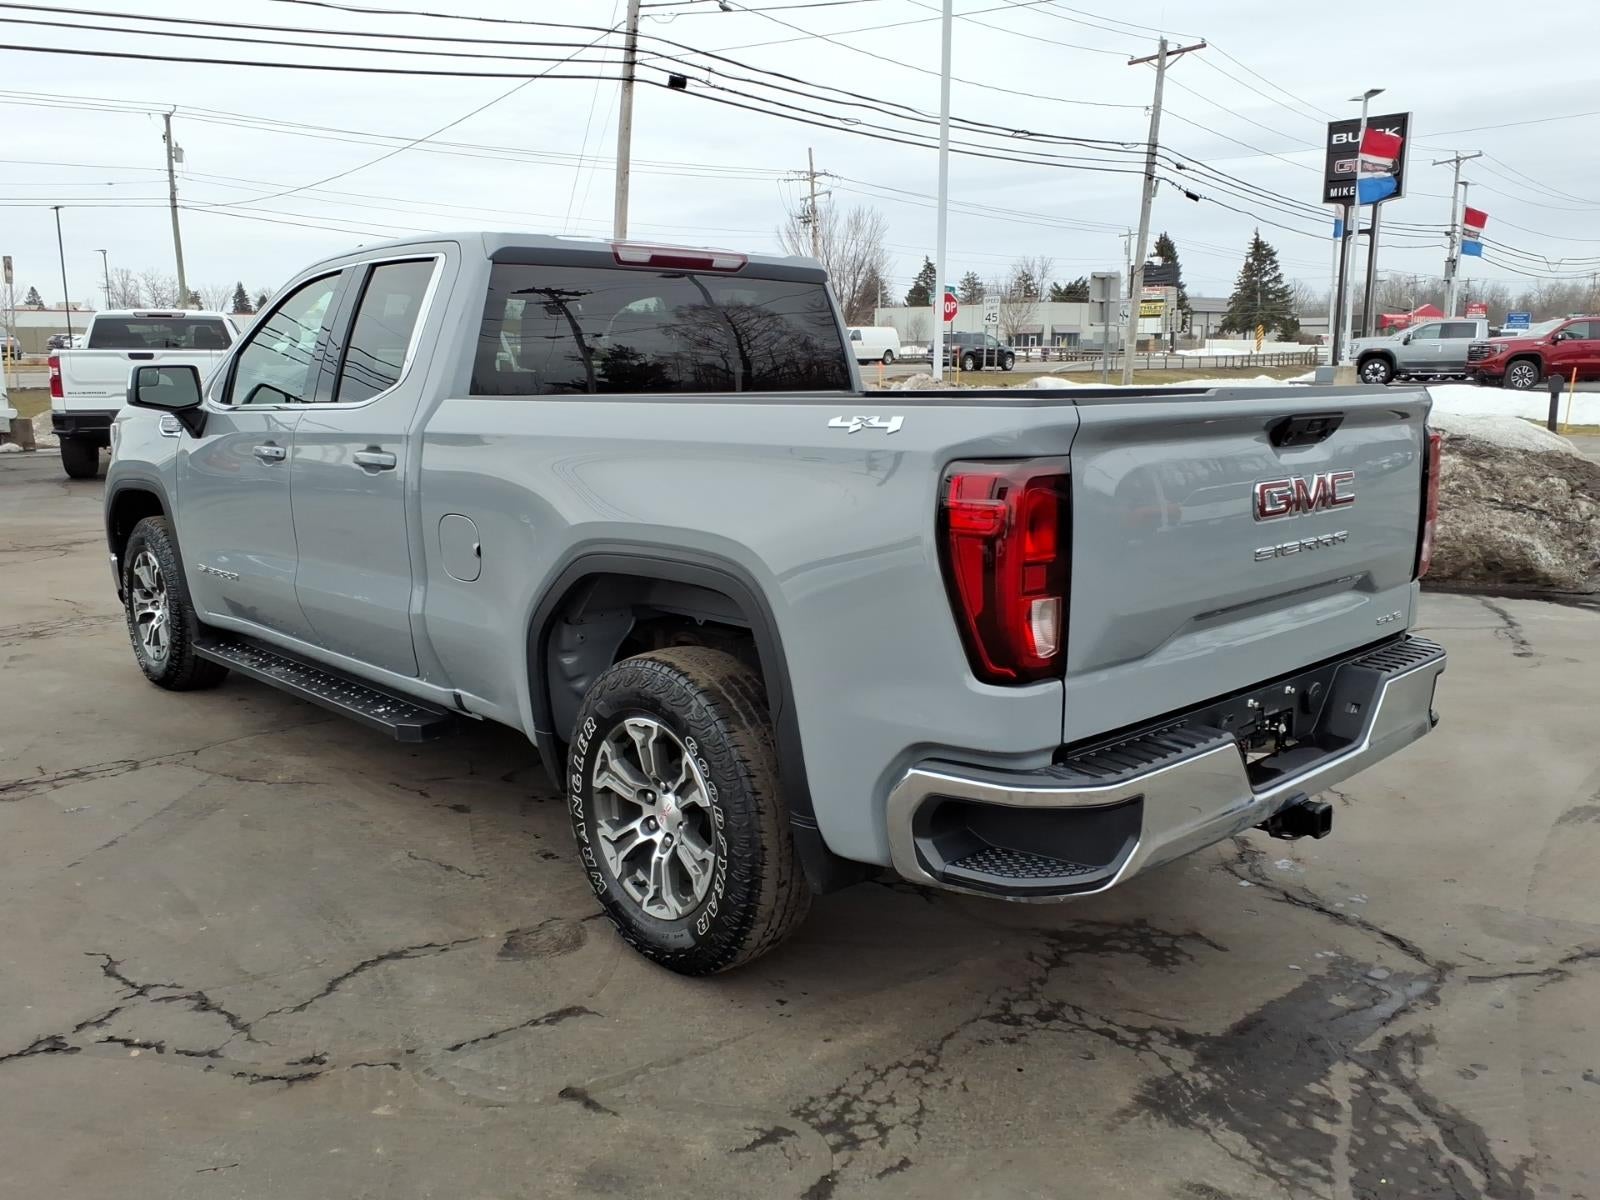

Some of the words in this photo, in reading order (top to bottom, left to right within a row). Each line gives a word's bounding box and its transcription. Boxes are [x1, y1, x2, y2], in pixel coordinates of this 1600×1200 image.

[1332, 127, 1400, 145] BUK
[1330, 186, 1356, 197] MIKE
[944, 301, 957, 313] OP
[985, 312, 998, 322] 45
[1253, 469, 1355, 522] GMC
[1254, 530, 1349, 561] SIERRA
[572, 716, 608, 896] WRANGLER
[685, 736, 728, 936] GOODYEAR
